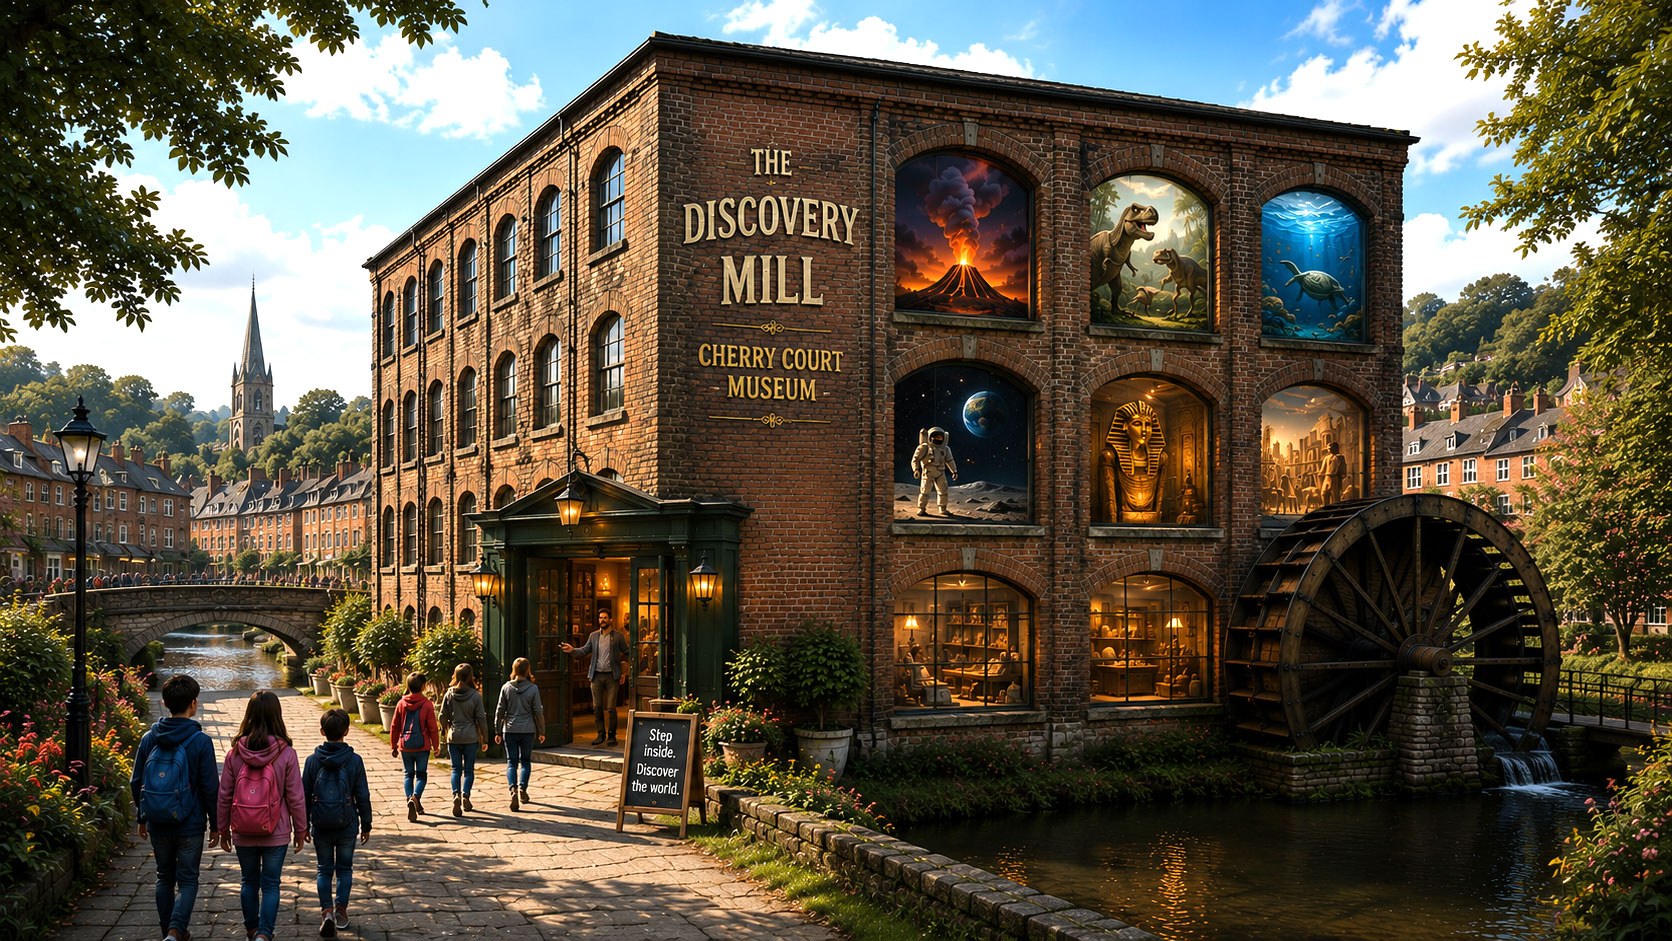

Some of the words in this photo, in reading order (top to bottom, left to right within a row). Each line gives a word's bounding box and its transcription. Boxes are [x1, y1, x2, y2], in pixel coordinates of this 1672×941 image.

[750, 147, 793, 177] THE
[683, 196, 859, 245] DISCOVERY
[720, 255, 824, 306] MILL
[698, 343, 777, 369] CHERRY
[781, 347, 844, 372] COURT
[726, 375, 817, 402] MUSEUM
[649, 728, 672, 745] Step
[644, 744, 676, 758] inside.
[636, 763, 679, 777] Discover
[632, 779, 647, 792] the
[650, 782, 680, 795] world.
